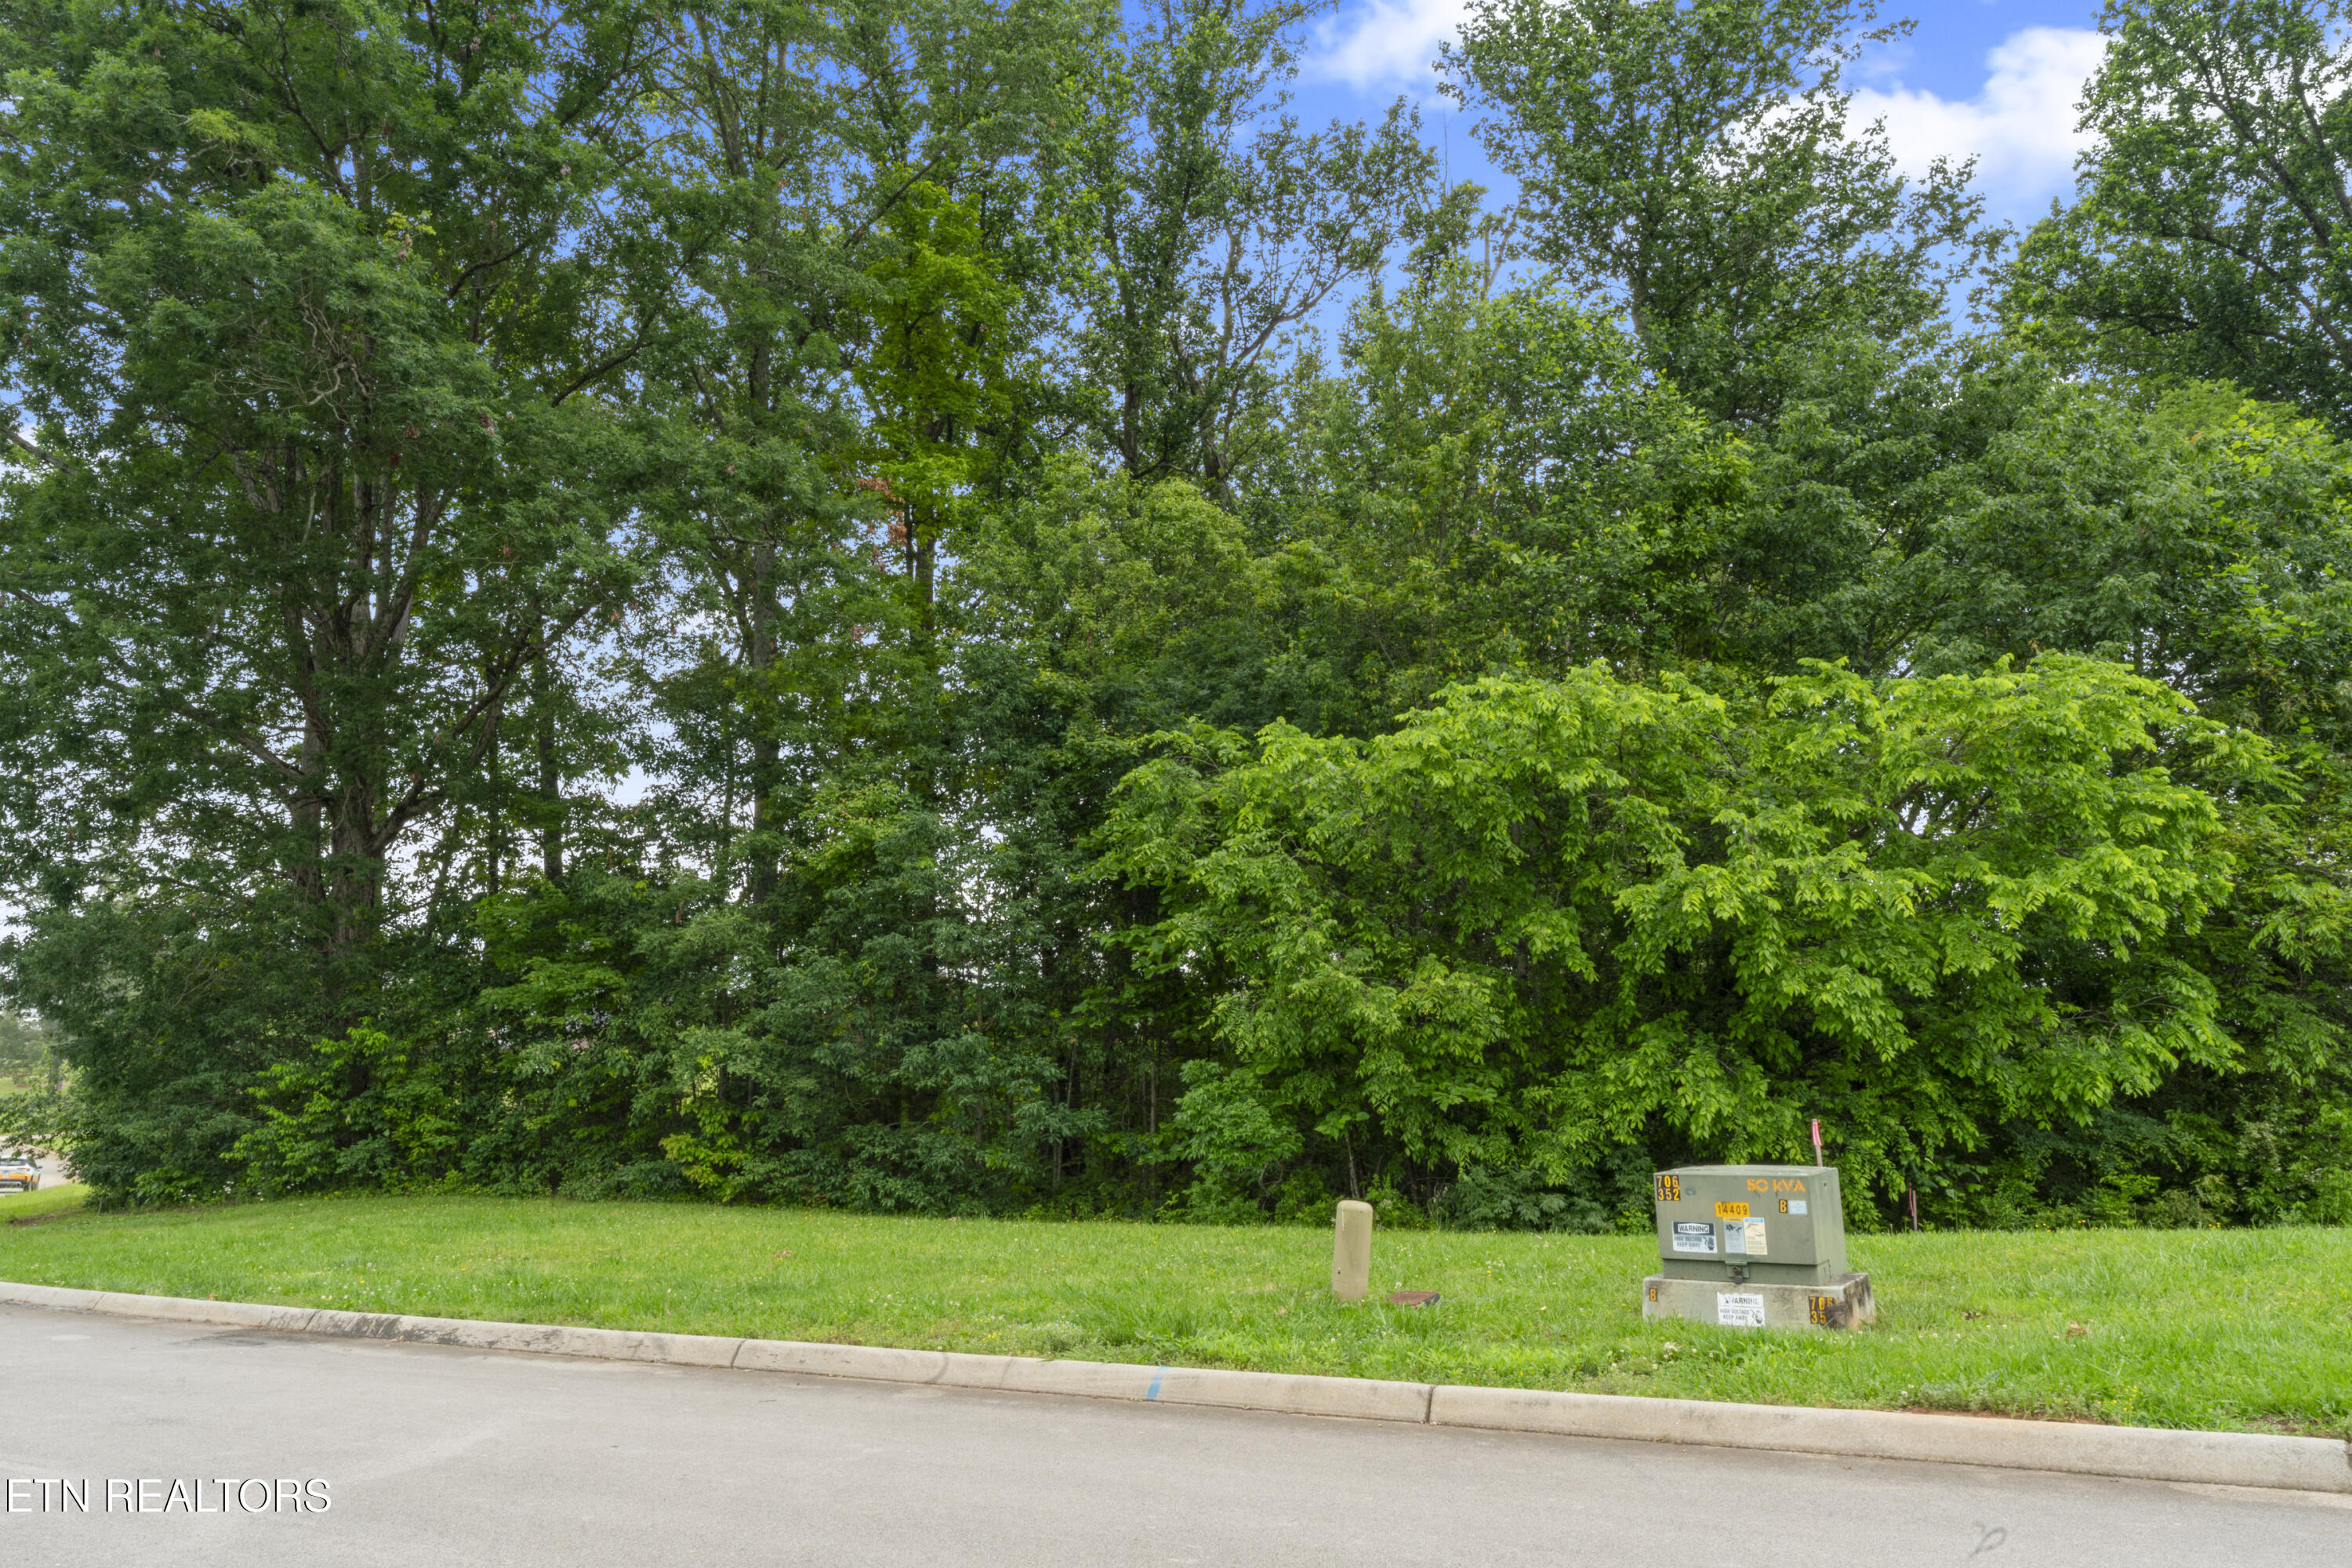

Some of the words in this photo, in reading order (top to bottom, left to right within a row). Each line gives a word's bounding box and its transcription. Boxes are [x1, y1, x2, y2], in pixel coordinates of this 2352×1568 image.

[1656, 1175, 1679, 1188] 706
[1747, 1178, 1769, 1192] 50
[1657, 1188, 1680, 1201] 352
[1718, 1204, 1748, 1215] 14409
[1780, 1200, 1788, 1213] B
[1679, 1225, 1709, 1233] WARNING
[1650, 1289, 1657, 1301] B
